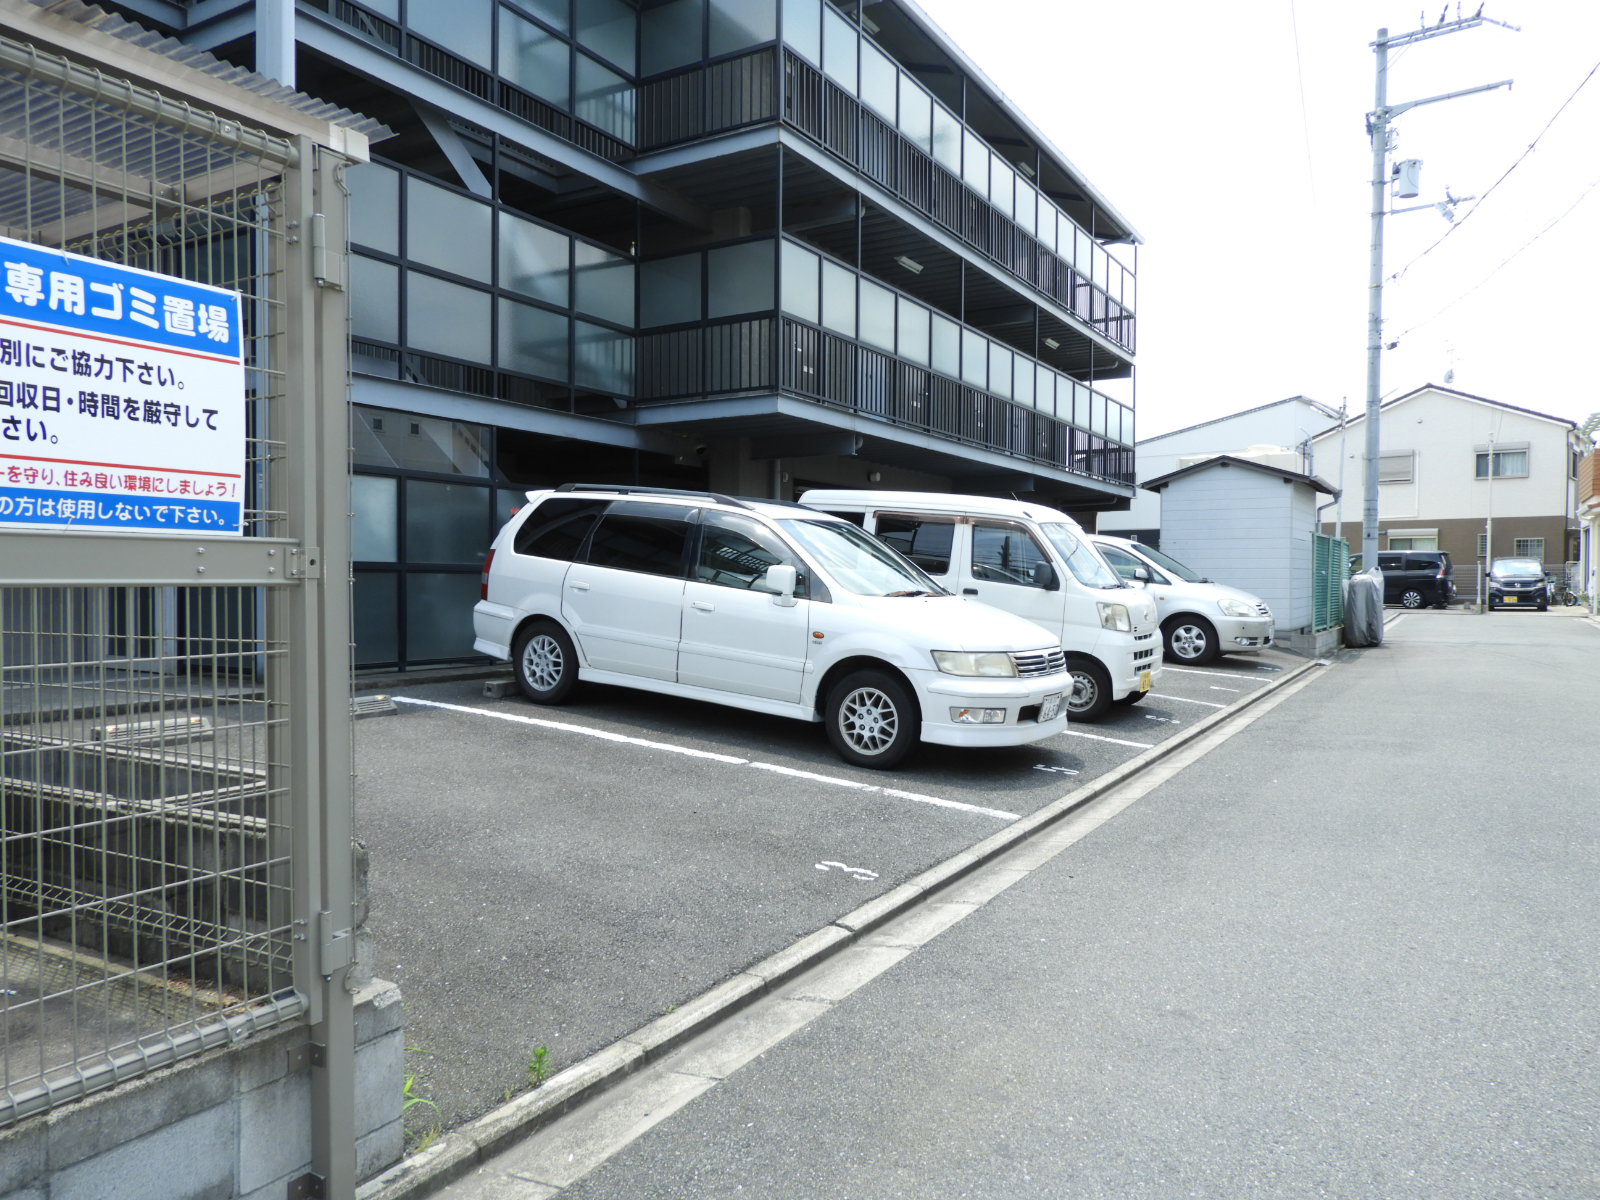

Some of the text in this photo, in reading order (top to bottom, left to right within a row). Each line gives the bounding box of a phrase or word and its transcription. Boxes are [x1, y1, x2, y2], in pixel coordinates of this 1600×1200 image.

[3, 261, 230, 343] 専用ゴミ置場
[0, 338, 185, 390] 別にご協力下さい。
[2, 415, 58, 444] さい。
